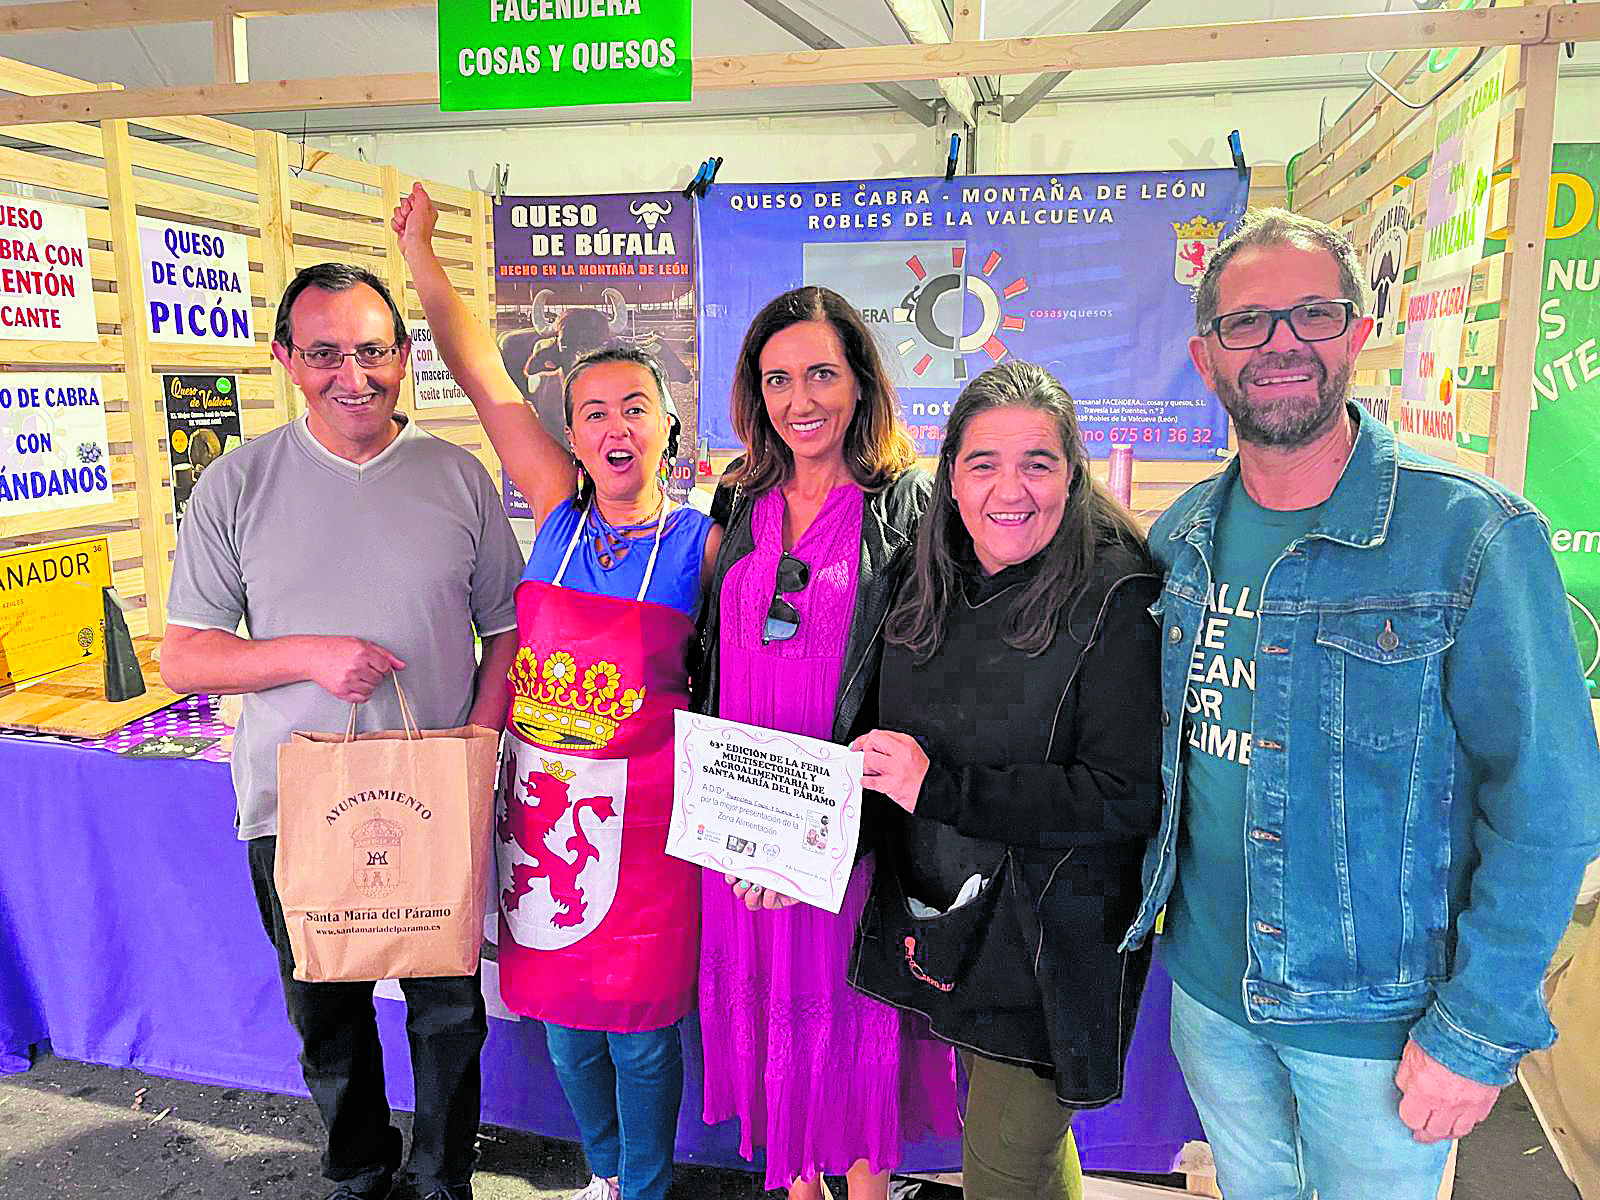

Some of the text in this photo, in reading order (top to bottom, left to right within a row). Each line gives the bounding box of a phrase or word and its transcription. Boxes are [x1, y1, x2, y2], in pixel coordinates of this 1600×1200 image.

[490, 0, 641, 22] FACENDERA
[458, 38, 676, 77] COSAS Y QUESOS
[1471, 72, 1500, 119] CABRA
[729, 194, 803, 211] QUESO
[815, 192, 842, 208] DE
[854, 190, 930, 207] CABRA
[962, 183, 1083, 203] MONTAÑA
[1097, 185, 1127, 200] DE
[1141, 180, 1206, 199] LEÓN
[511, 204, 598, 228] QUESO
[808, 208, 1113, 230] ROBLES DE LA VALCUEVA
[164, 228, 225, 259] QUESO
[532, 228, 676, 257] DE BÚFALA
[1427, 207, 1475, 262] MANZANA
[45, 244, 84, 267] CON
[151, 261, 242, 293] DE CABRA
[500, 262, 689, 276] HECHO EN LA MONTAÑA DE LEÓN
[1439, 286, 1465, 318] CABRA
[1, 306, 61, 328] CANTE
[150, 297, 250, 338] PICÓN
[1030, 310, 1113, 320] cosasyquesos
[411, 328, 432, 341] UESO
[416, 349, 433, 361] con
[1419, 351, 1435, 378] CON
[170, 376, 198, 398] Queso
[415, 371, 420, 385] y
[17, 388, 40, 408] DE
[45, 387, 100, 407] CABRA
[420, 387, 440, 400] aceite
[1157, 415, 1178, 423] (León)
[1416, 408, 1420, 434] Y
[1423, 409, 1453, 441] MANGO
[16, 432, 52, 454] CON
[1109, 428, 1138, 442] 675
[1143, 428, 1160, 442] 81
[1168, 428, 1187, 442] 36
[1191, 428, 1213, 443] 32
[670, 464, 691, 480] UD
[1189, 651, 1256, 691] EAN
[722, 751, 817, 782] MULTISECTORIAL Y
[726, 743, 767, 760] EDICIÓN
[769, 753, 783, 764] DE
[785, 757, 799, 768] LA
[800, 761, 831, 777] FERIA
[702, 765, 836, 807] SANTA MARÍA DEL PÁRAMO
[714, 759, 825, 795] AGROALIMENTARIA DE
[325, 789, 432, 826] AYUNTAMIENTO
[700, 795, 712, 803] por
[717, 811, 777, 836] Zona Alimentación
[306, 907, 452, 922] Santa María del Páramo
